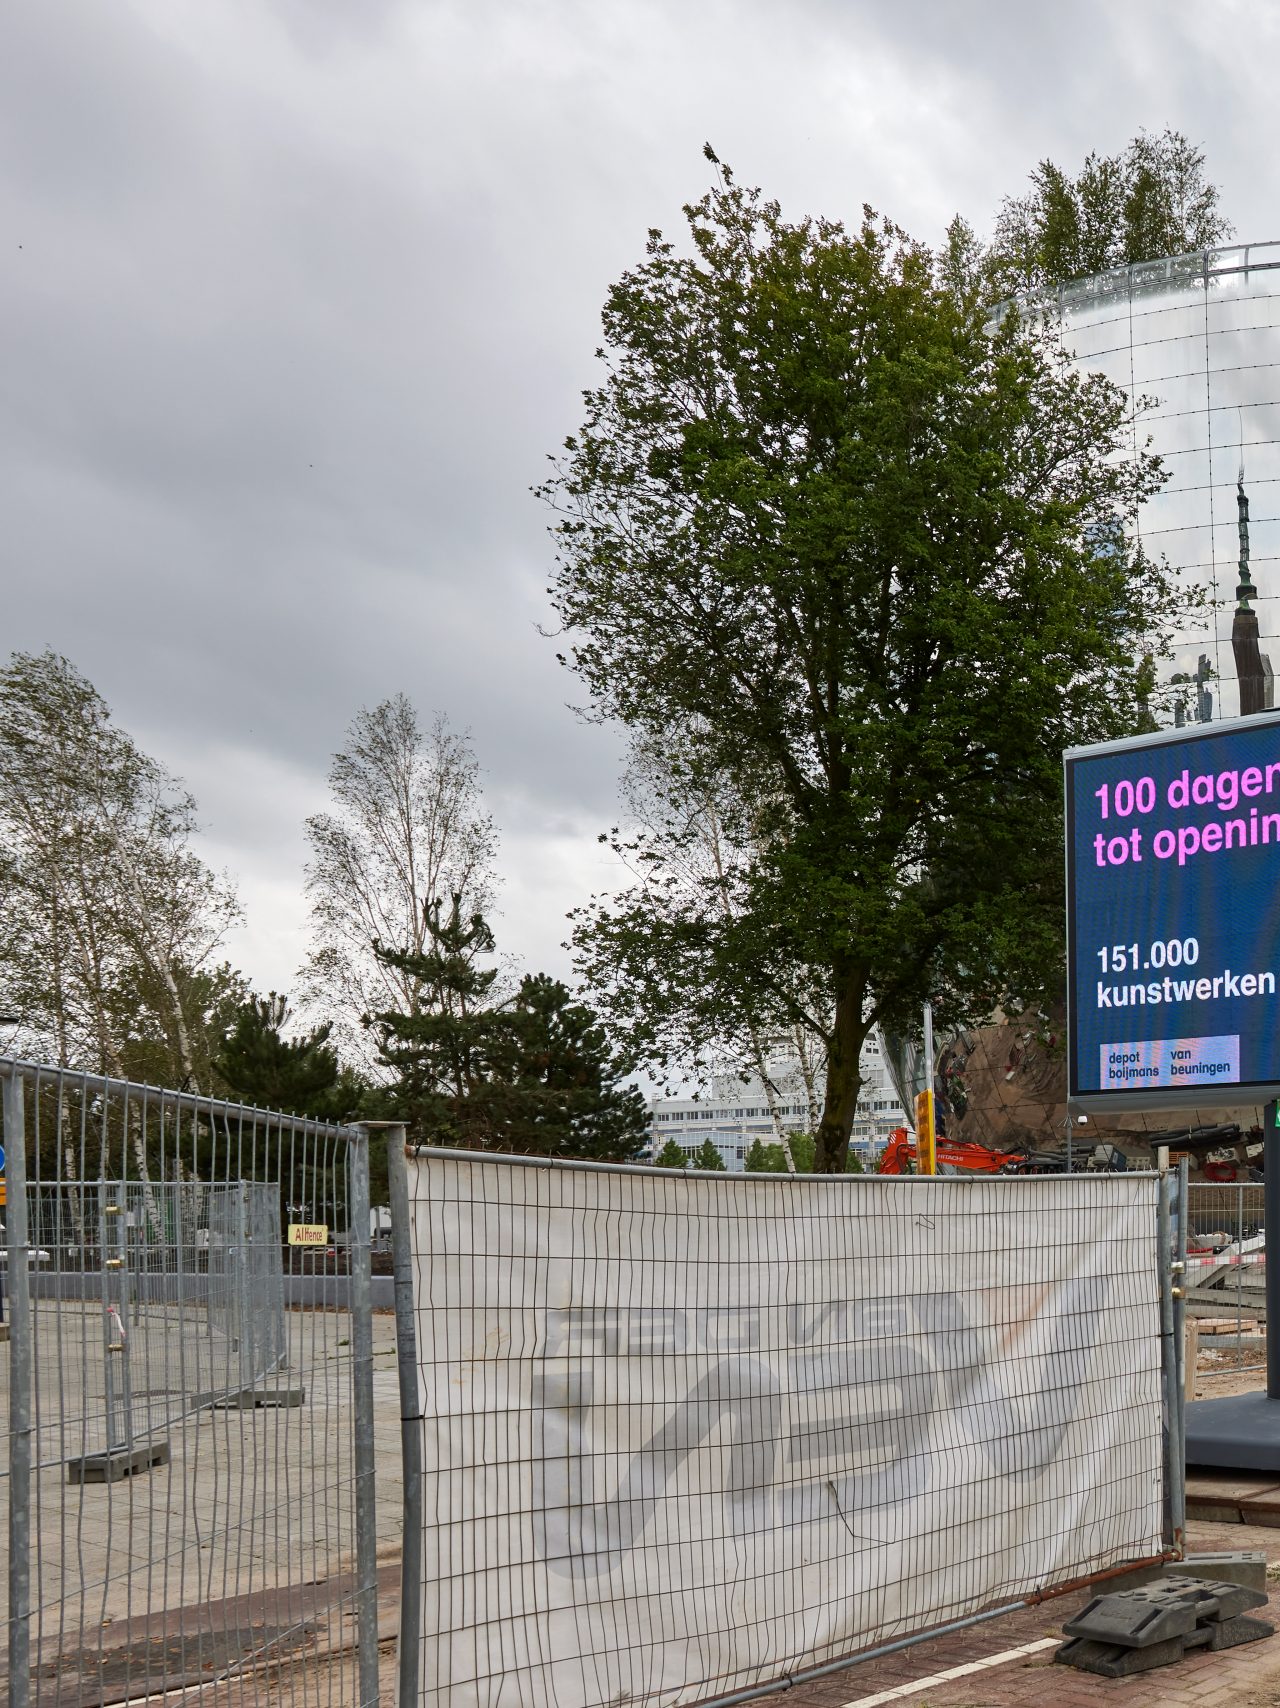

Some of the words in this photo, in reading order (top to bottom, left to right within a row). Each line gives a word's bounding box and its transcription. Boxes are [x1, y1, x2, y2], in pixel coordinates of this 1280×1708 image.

[1095, 775, 1156, 819] 100
[1094, 829, 1142, 867] tot
[1097, 937, 1199, 973] 151.000
[1097, 969, 1276, 1008] kunstwerken
[1108, 1050, 1141, 1067] depot
[1171, 1049, 1191, 1060] van
[1108, 1064, 1160, 1080] boijmans
[1171, 1059, 1231, 1076] beuningen
